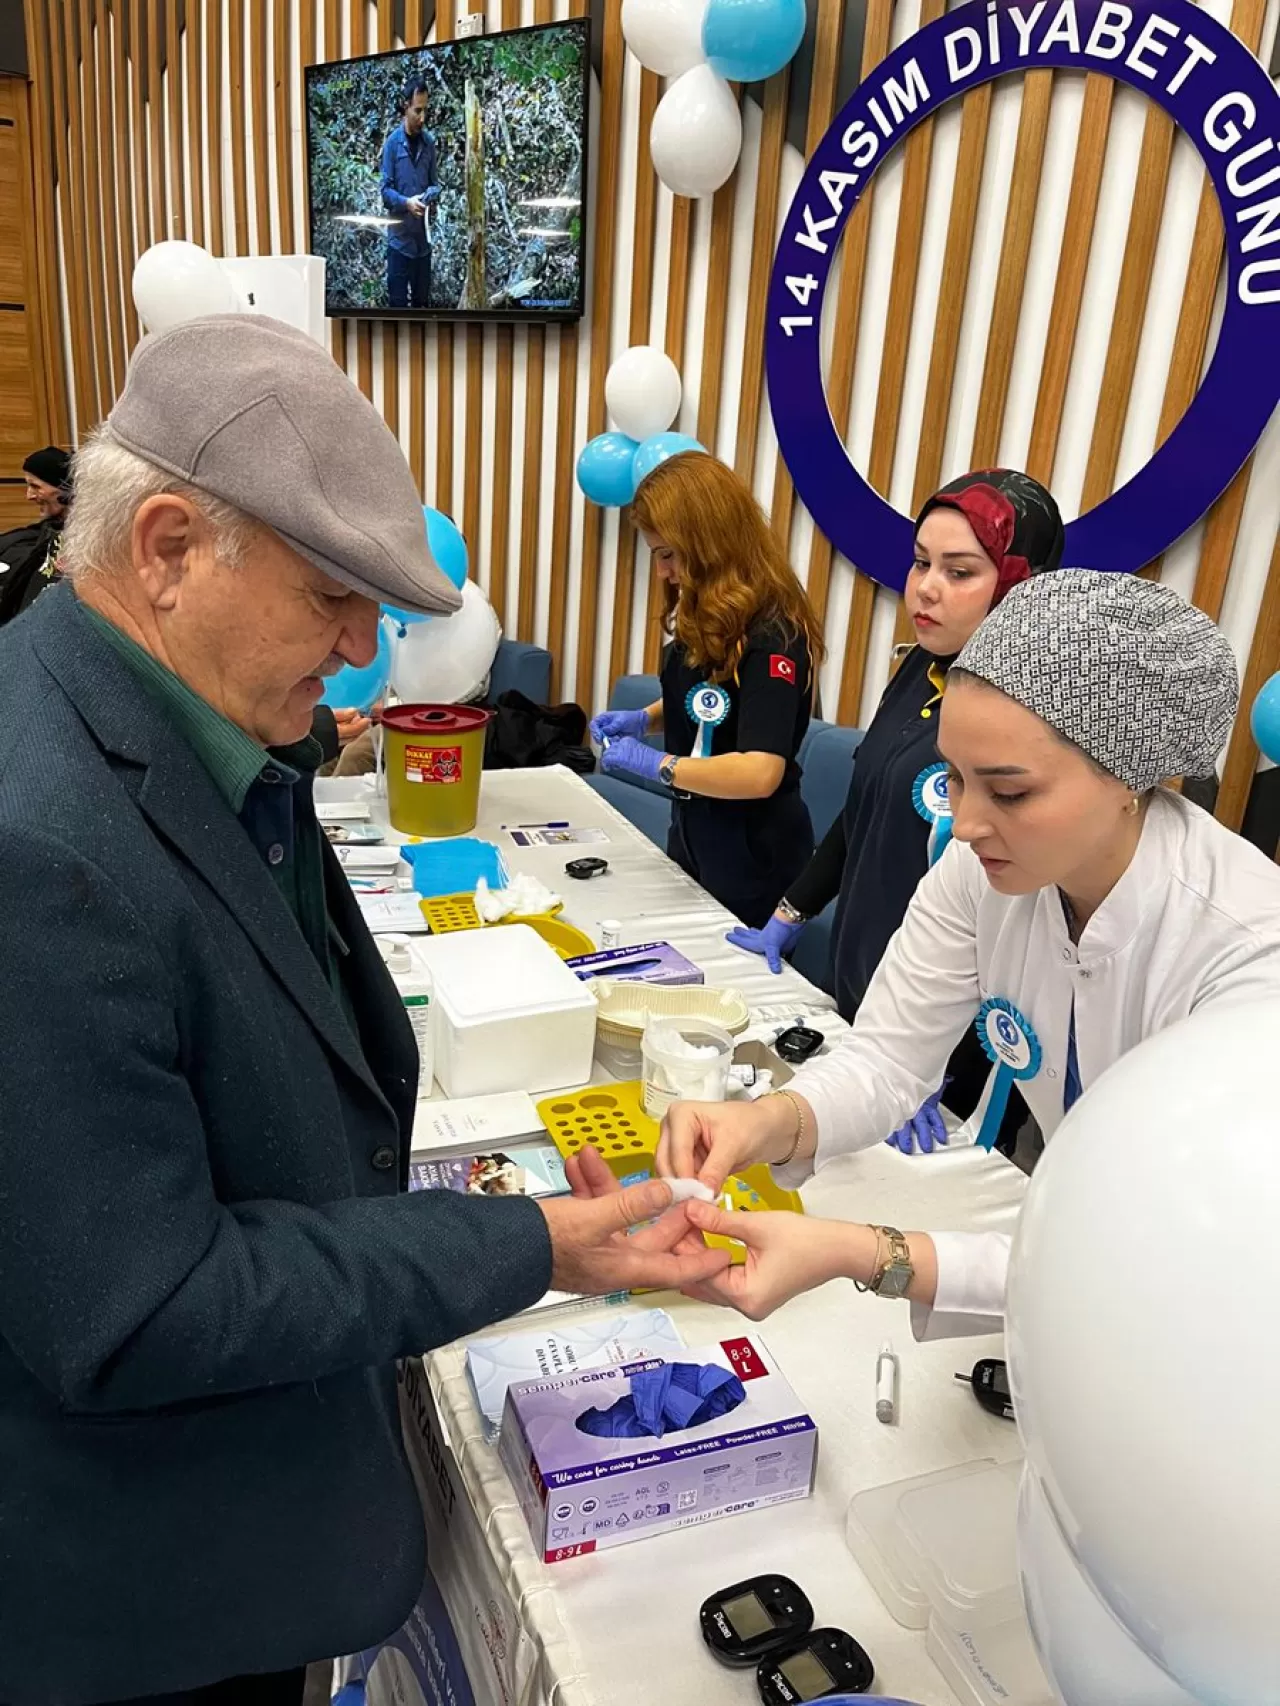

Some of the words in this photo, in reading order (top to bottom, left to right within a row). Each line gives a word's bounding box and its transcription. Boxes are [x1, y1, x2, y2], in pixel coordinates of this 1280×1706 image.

[944, 0, 1217, 95] DİYABET
[795, 57, 931, 254] KASIM
[779, 273, 819, 337] 14
[731, 1346, 751, 1361] 8-9
[741, 1361, 751, 1373] L
[552, 1472, 573, 1484] We
[574, 1470, 593, 1479] care
[595, 1466, 608, 1477] for
[610, 1461, 635, 1470] caring
[637, 1454, 661, 1465] hands
[555, 1546, 575, 1561] 8-9
[576, 1544, 582, 1555] L
